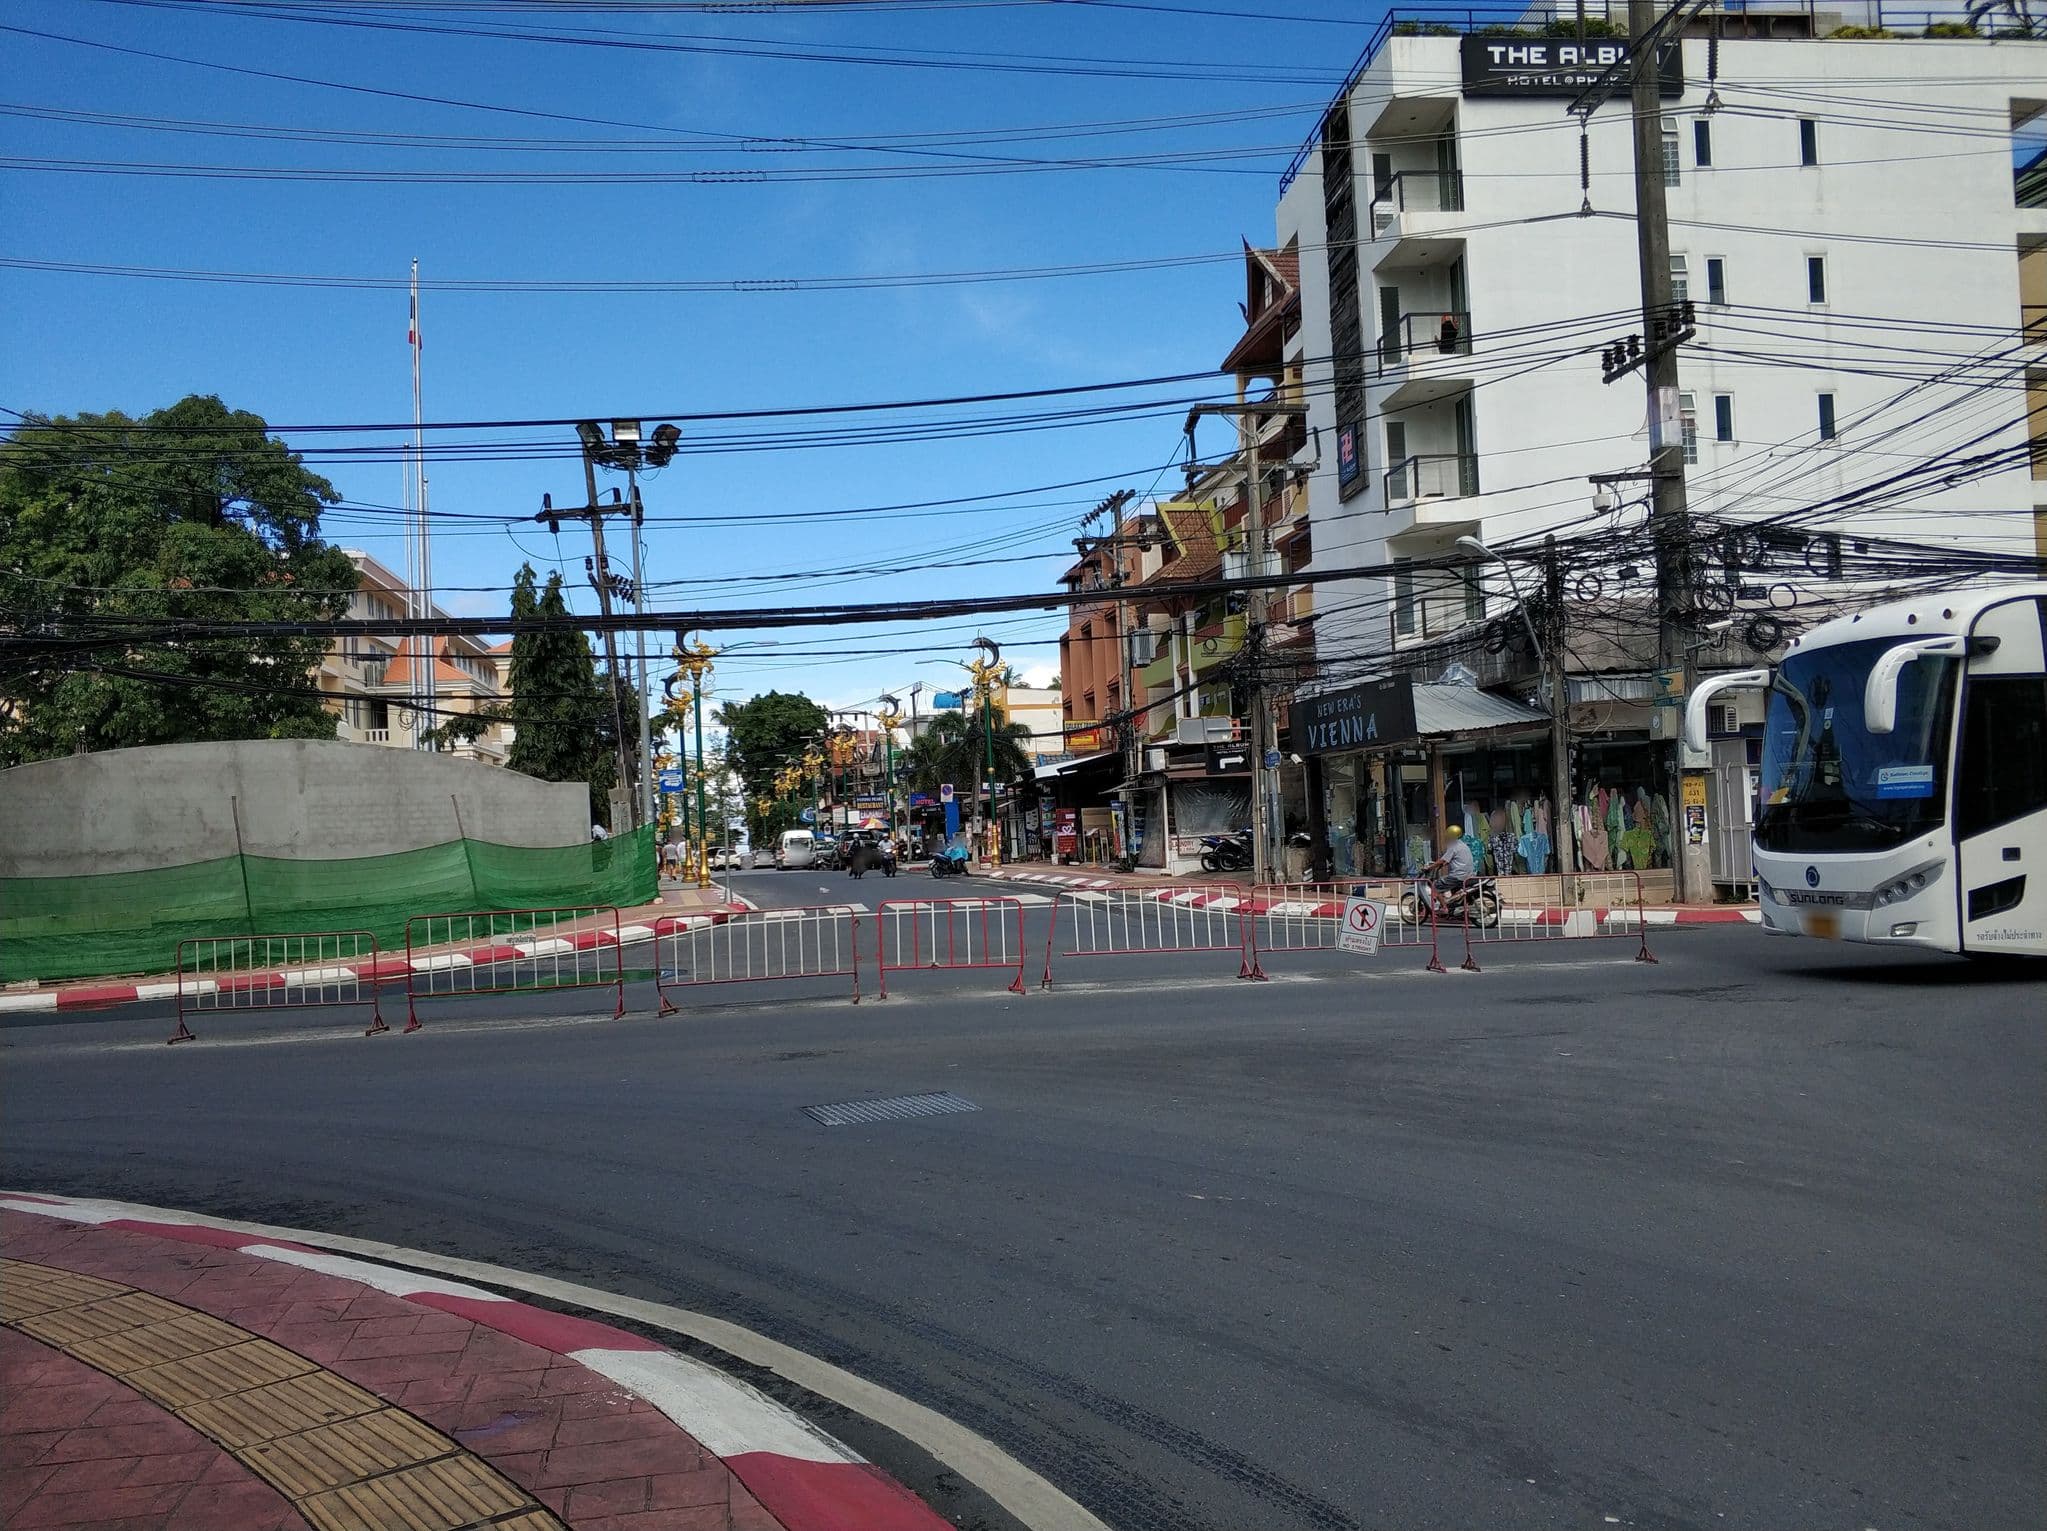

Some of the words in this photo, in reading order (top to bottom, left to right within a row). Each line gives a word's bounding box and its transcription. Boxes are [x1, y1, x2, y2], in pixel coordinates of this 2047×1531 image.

[1487, 46, 1547, 65] THE
[1317, 701, 1335, 718] NEW
[1337, 694, 1361, 713] ERA'S
[1308, 713, 1378, 749] VIENNA
[1790, 893, 1845, 905] SUNLONG
